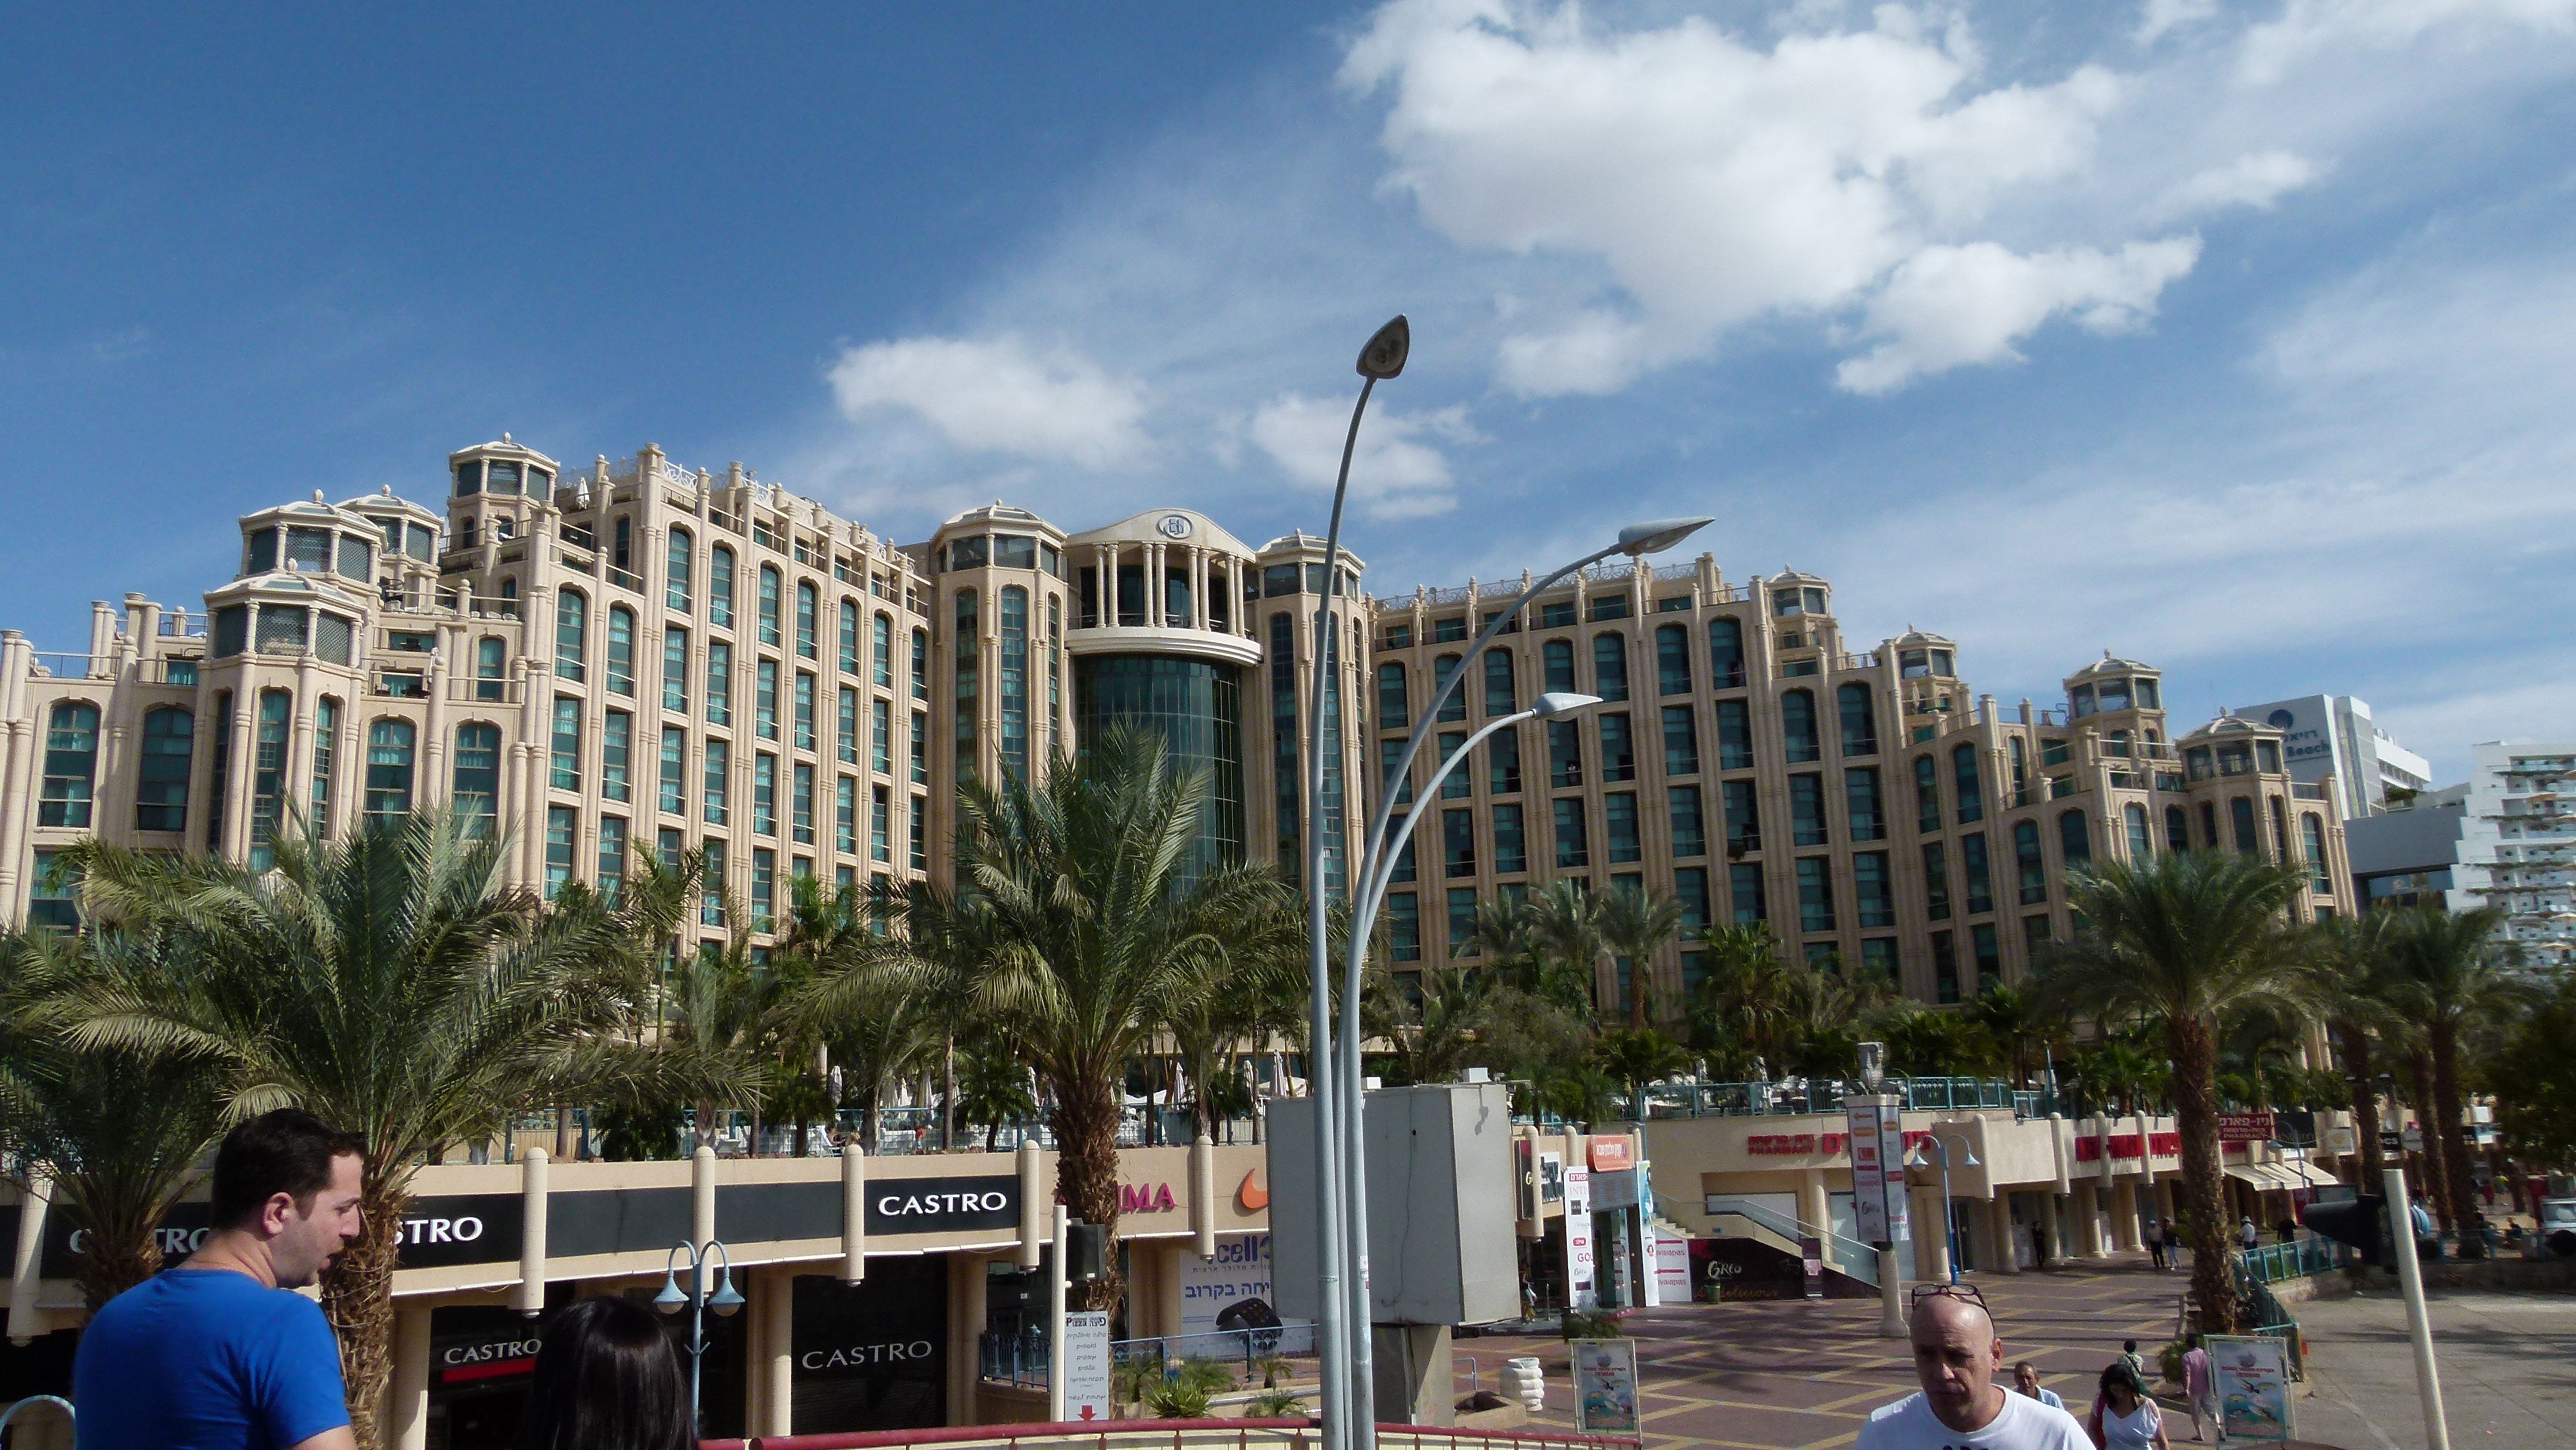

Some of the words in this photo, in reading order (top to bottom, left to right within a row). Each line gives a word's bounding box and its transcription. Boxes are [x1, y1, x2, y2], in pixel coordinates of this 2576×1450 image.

[878, 1192, 1007, 1216] CASTRO
[1117, 1182, 1177, 1210] IMA
[391, 1217, 483, 1245] TRO
[1185, 1284, 1236, 1300] בקרוב
[1241, 1282, 1270, 1295] יחה
[1066, 1317, 1087, 1327] Pizza
[1089, 1316, 1107, 1327] פיצה
[444, 1339, 542, 1364] CASTRO
[802, 1340, 932, 1370] CASTRO
